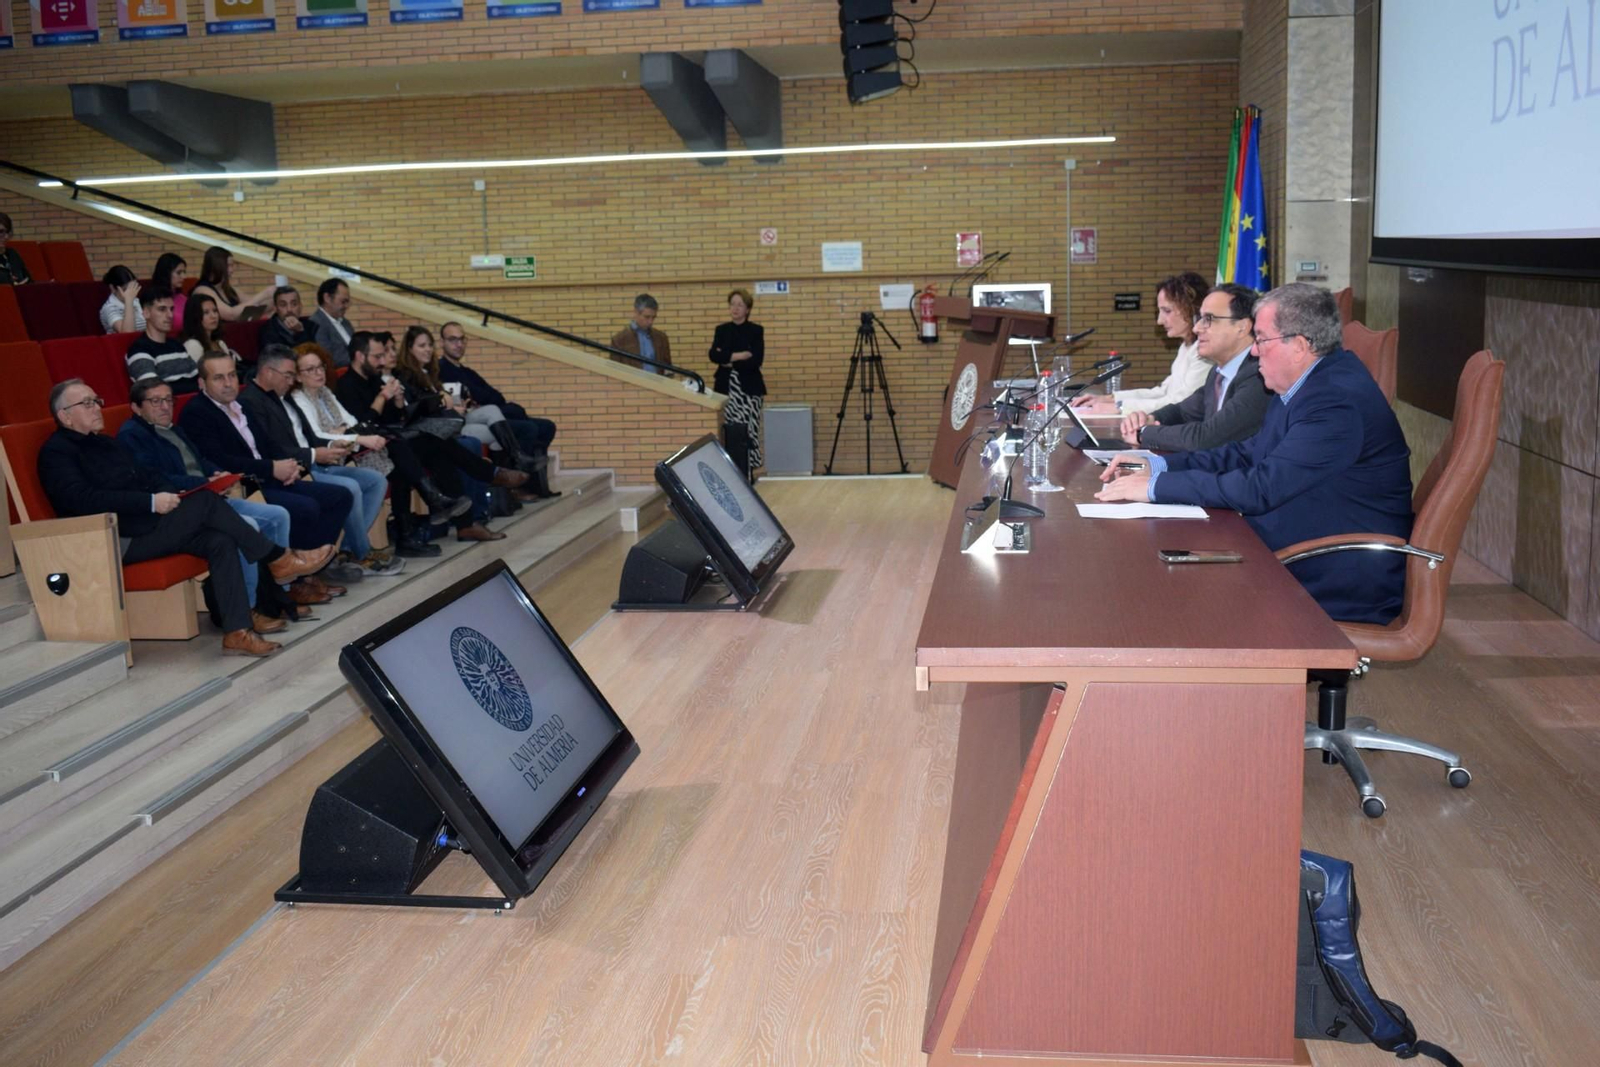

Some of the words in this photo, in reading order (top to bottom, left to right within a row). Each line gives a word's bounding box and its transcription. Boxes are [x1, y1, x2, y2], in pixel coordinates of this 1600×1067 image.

[1491, 22, 1538, 124] DE
[509, 714, 565, 772] UNIVERSIDAD
[523, 766, 544, 791] DE
